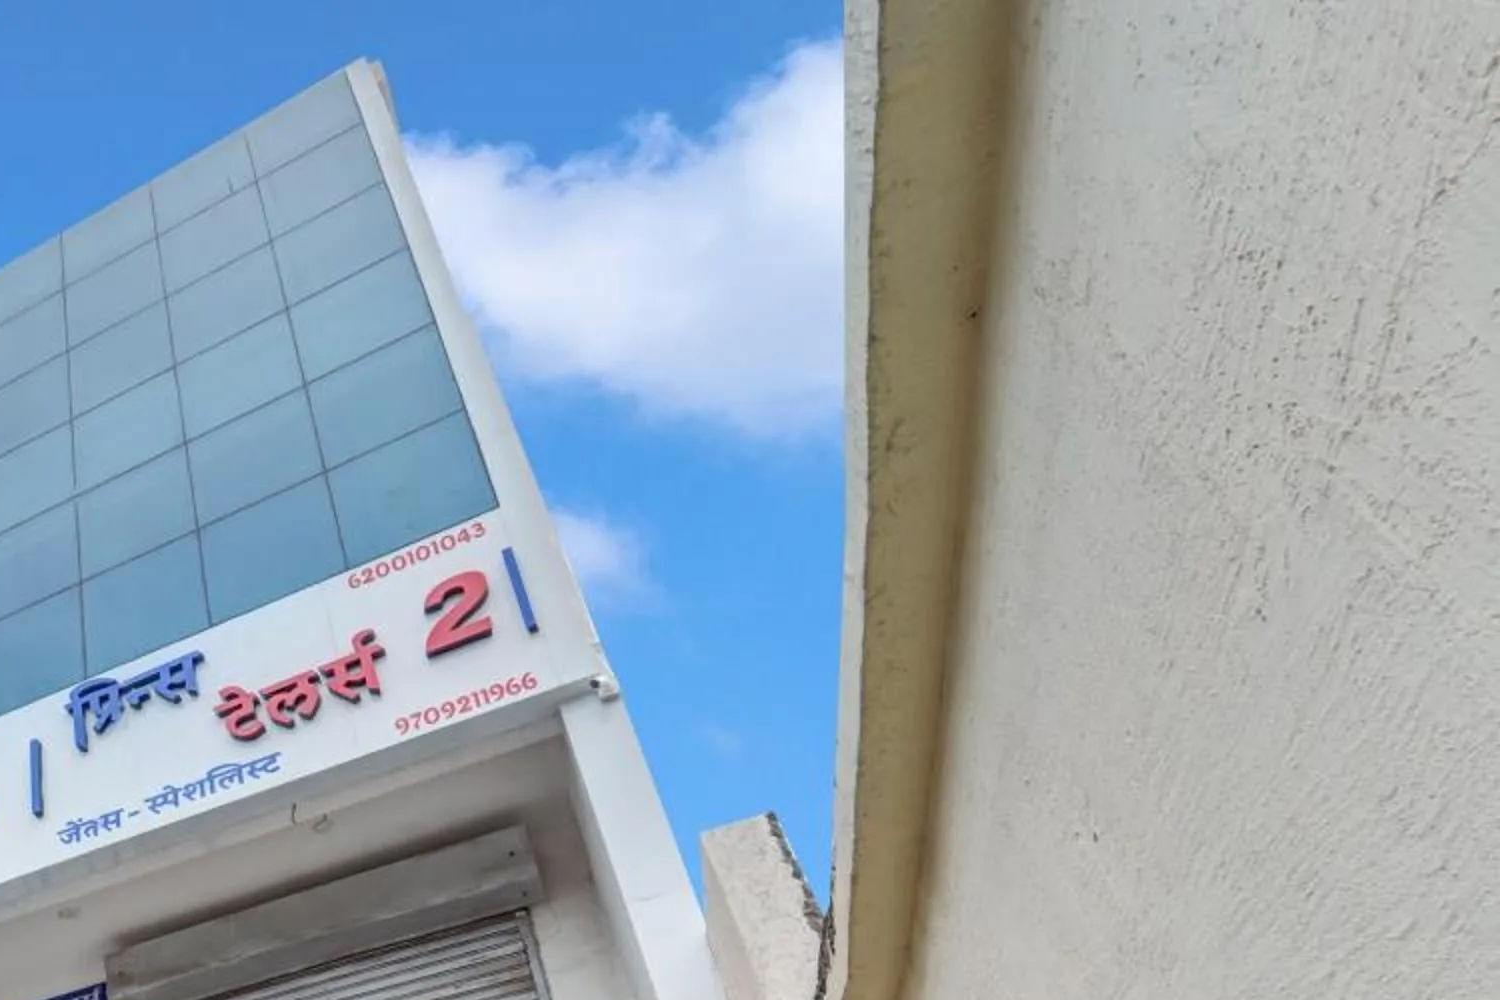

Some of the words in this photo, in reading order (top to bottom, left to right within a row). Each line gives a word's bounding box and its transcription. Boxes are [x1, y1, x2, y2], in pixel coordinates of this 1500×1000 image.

[347, 522, 487, 590] 6200101043
[66, 650, 205, 753] प्रिन्स
[215, 628, 386, 742] टेलर्स
[423, 569, 494, 660] 2
[395, 671, 539, 736] 9709211966
